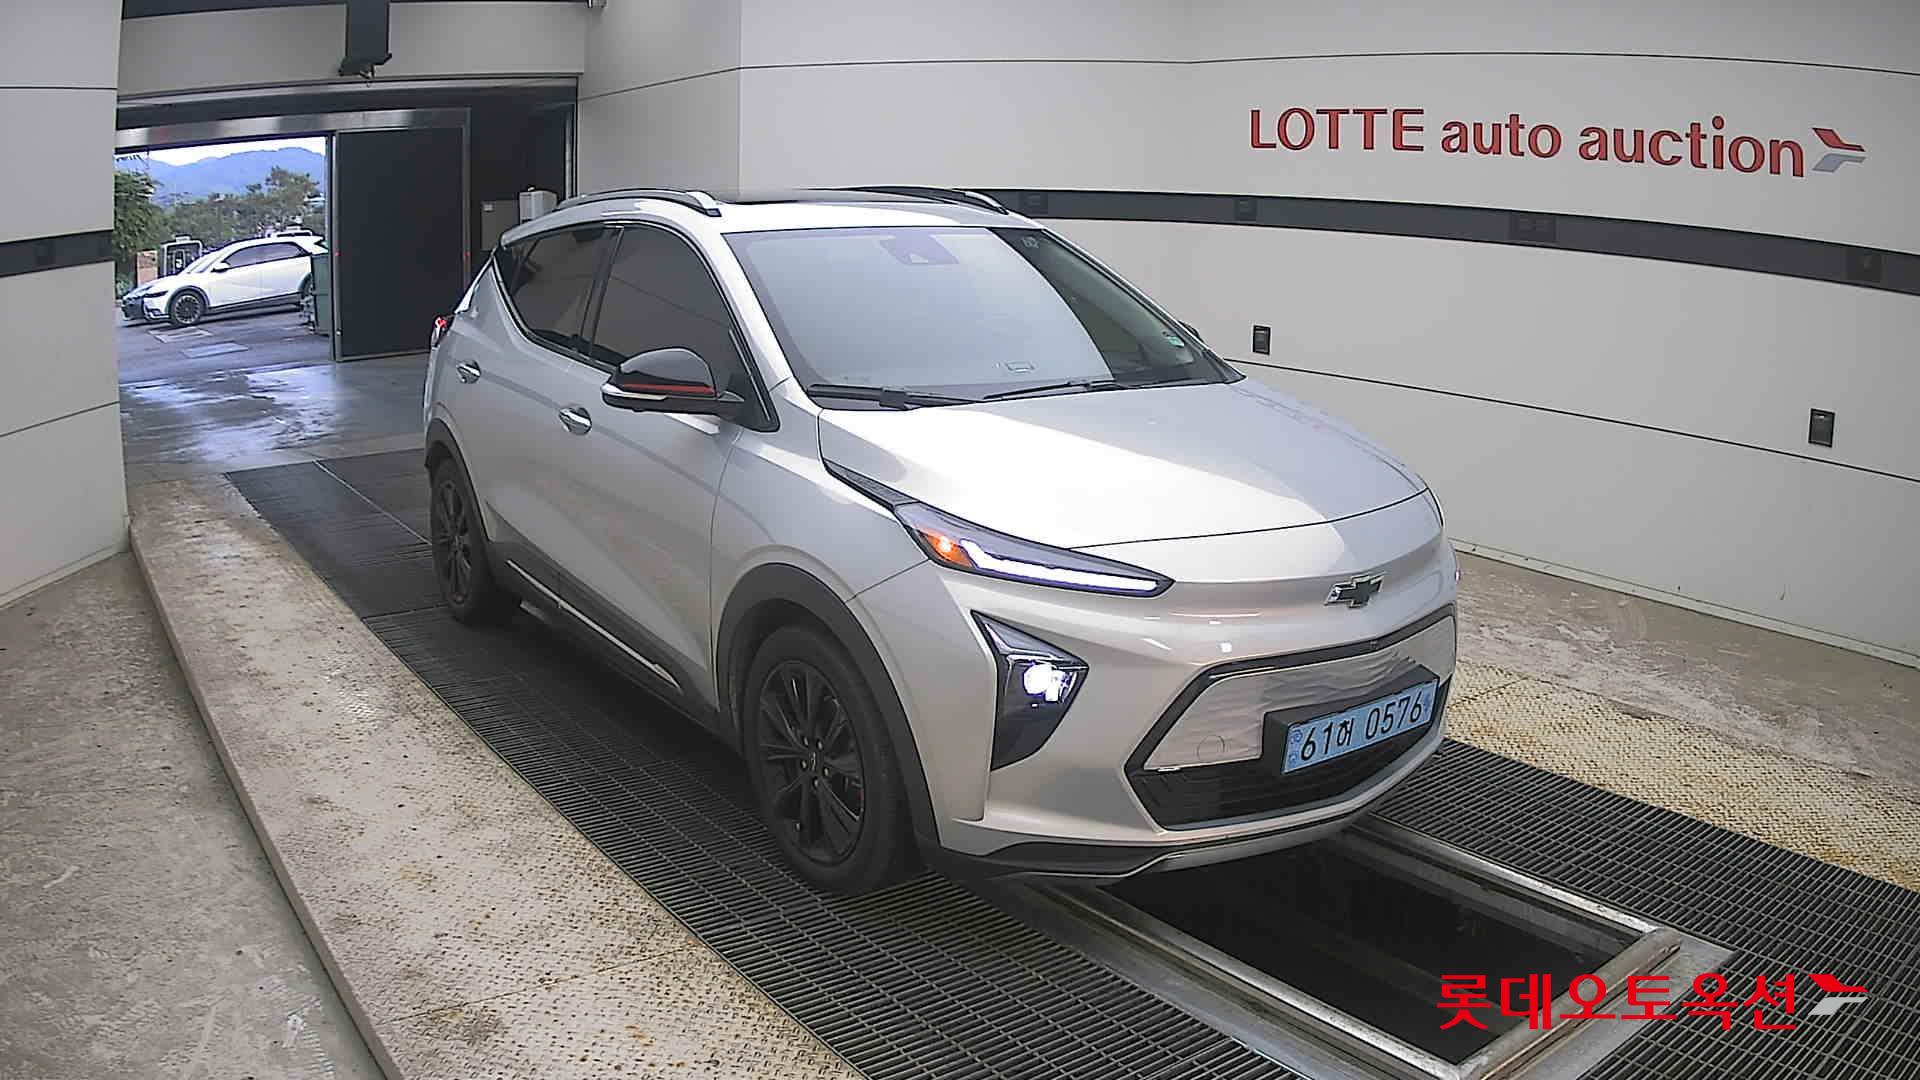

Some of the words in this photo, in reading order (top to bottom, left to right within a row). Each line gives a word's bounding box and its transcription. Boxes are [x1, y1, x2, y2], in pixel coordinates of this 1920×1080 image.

[1250, 107, 1425, 152] LOTTE
[1441, 114, 1564, 159] auto
[1577, 116, 1806, 178] auction
[1301, 717, 1354, 761] 61허
[1365, 690, 1422, 740] 0576
